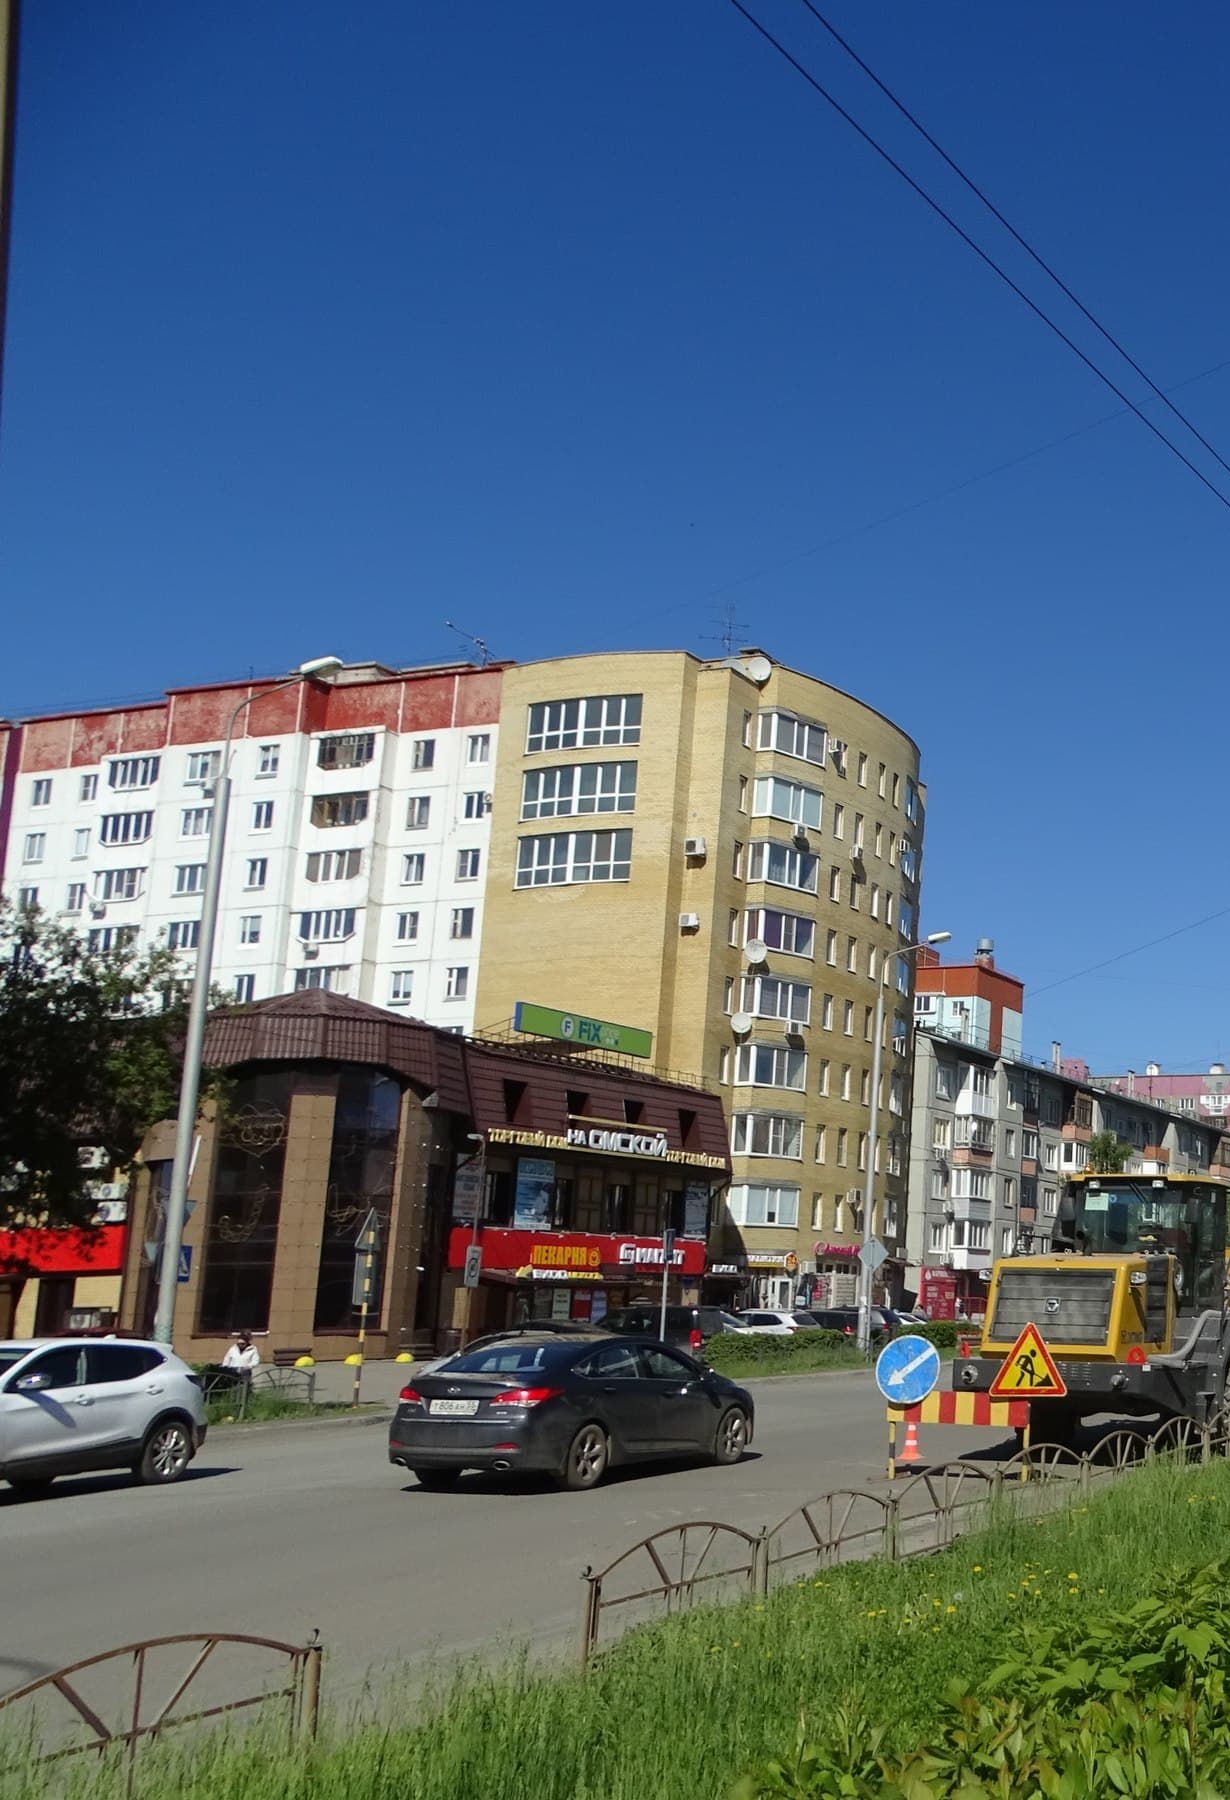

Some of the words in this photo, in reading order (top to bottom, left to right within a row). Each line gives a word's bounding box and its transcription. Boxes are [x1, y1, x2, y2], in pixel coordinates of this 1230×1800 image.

[567, 1128, 587, 1145] НА
[589, 1128, 667, 1157] ОМСКОЙ
[532, 1245, 587, 1266] ПЕКАРНЯ
